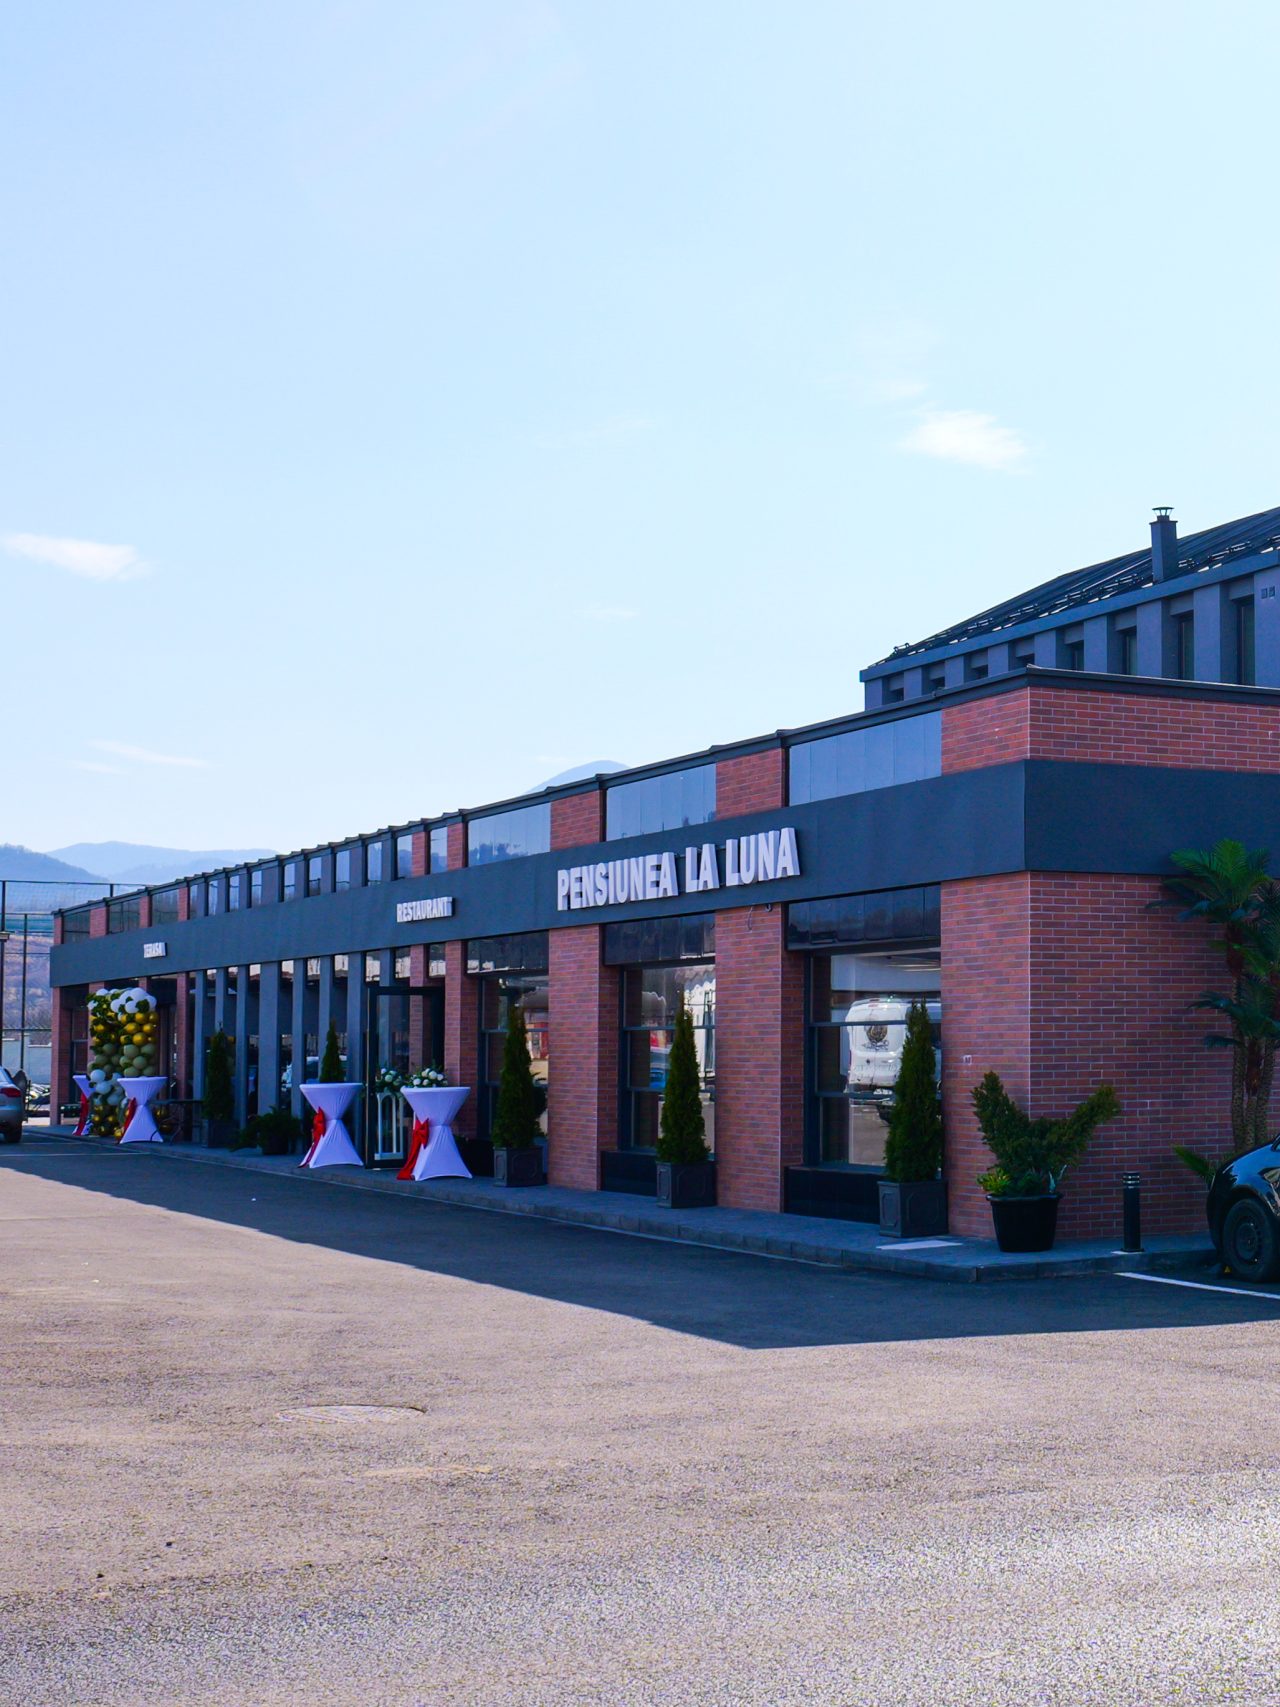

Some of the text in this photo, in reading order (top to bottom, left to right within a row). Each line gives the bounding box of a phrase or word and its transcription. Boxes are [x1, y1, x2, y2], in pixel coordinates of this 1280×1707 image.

[557, 827, 800, 911] PENSIUNEA LA LUNA
[396, 896, 453, 923] RESTAURANT
